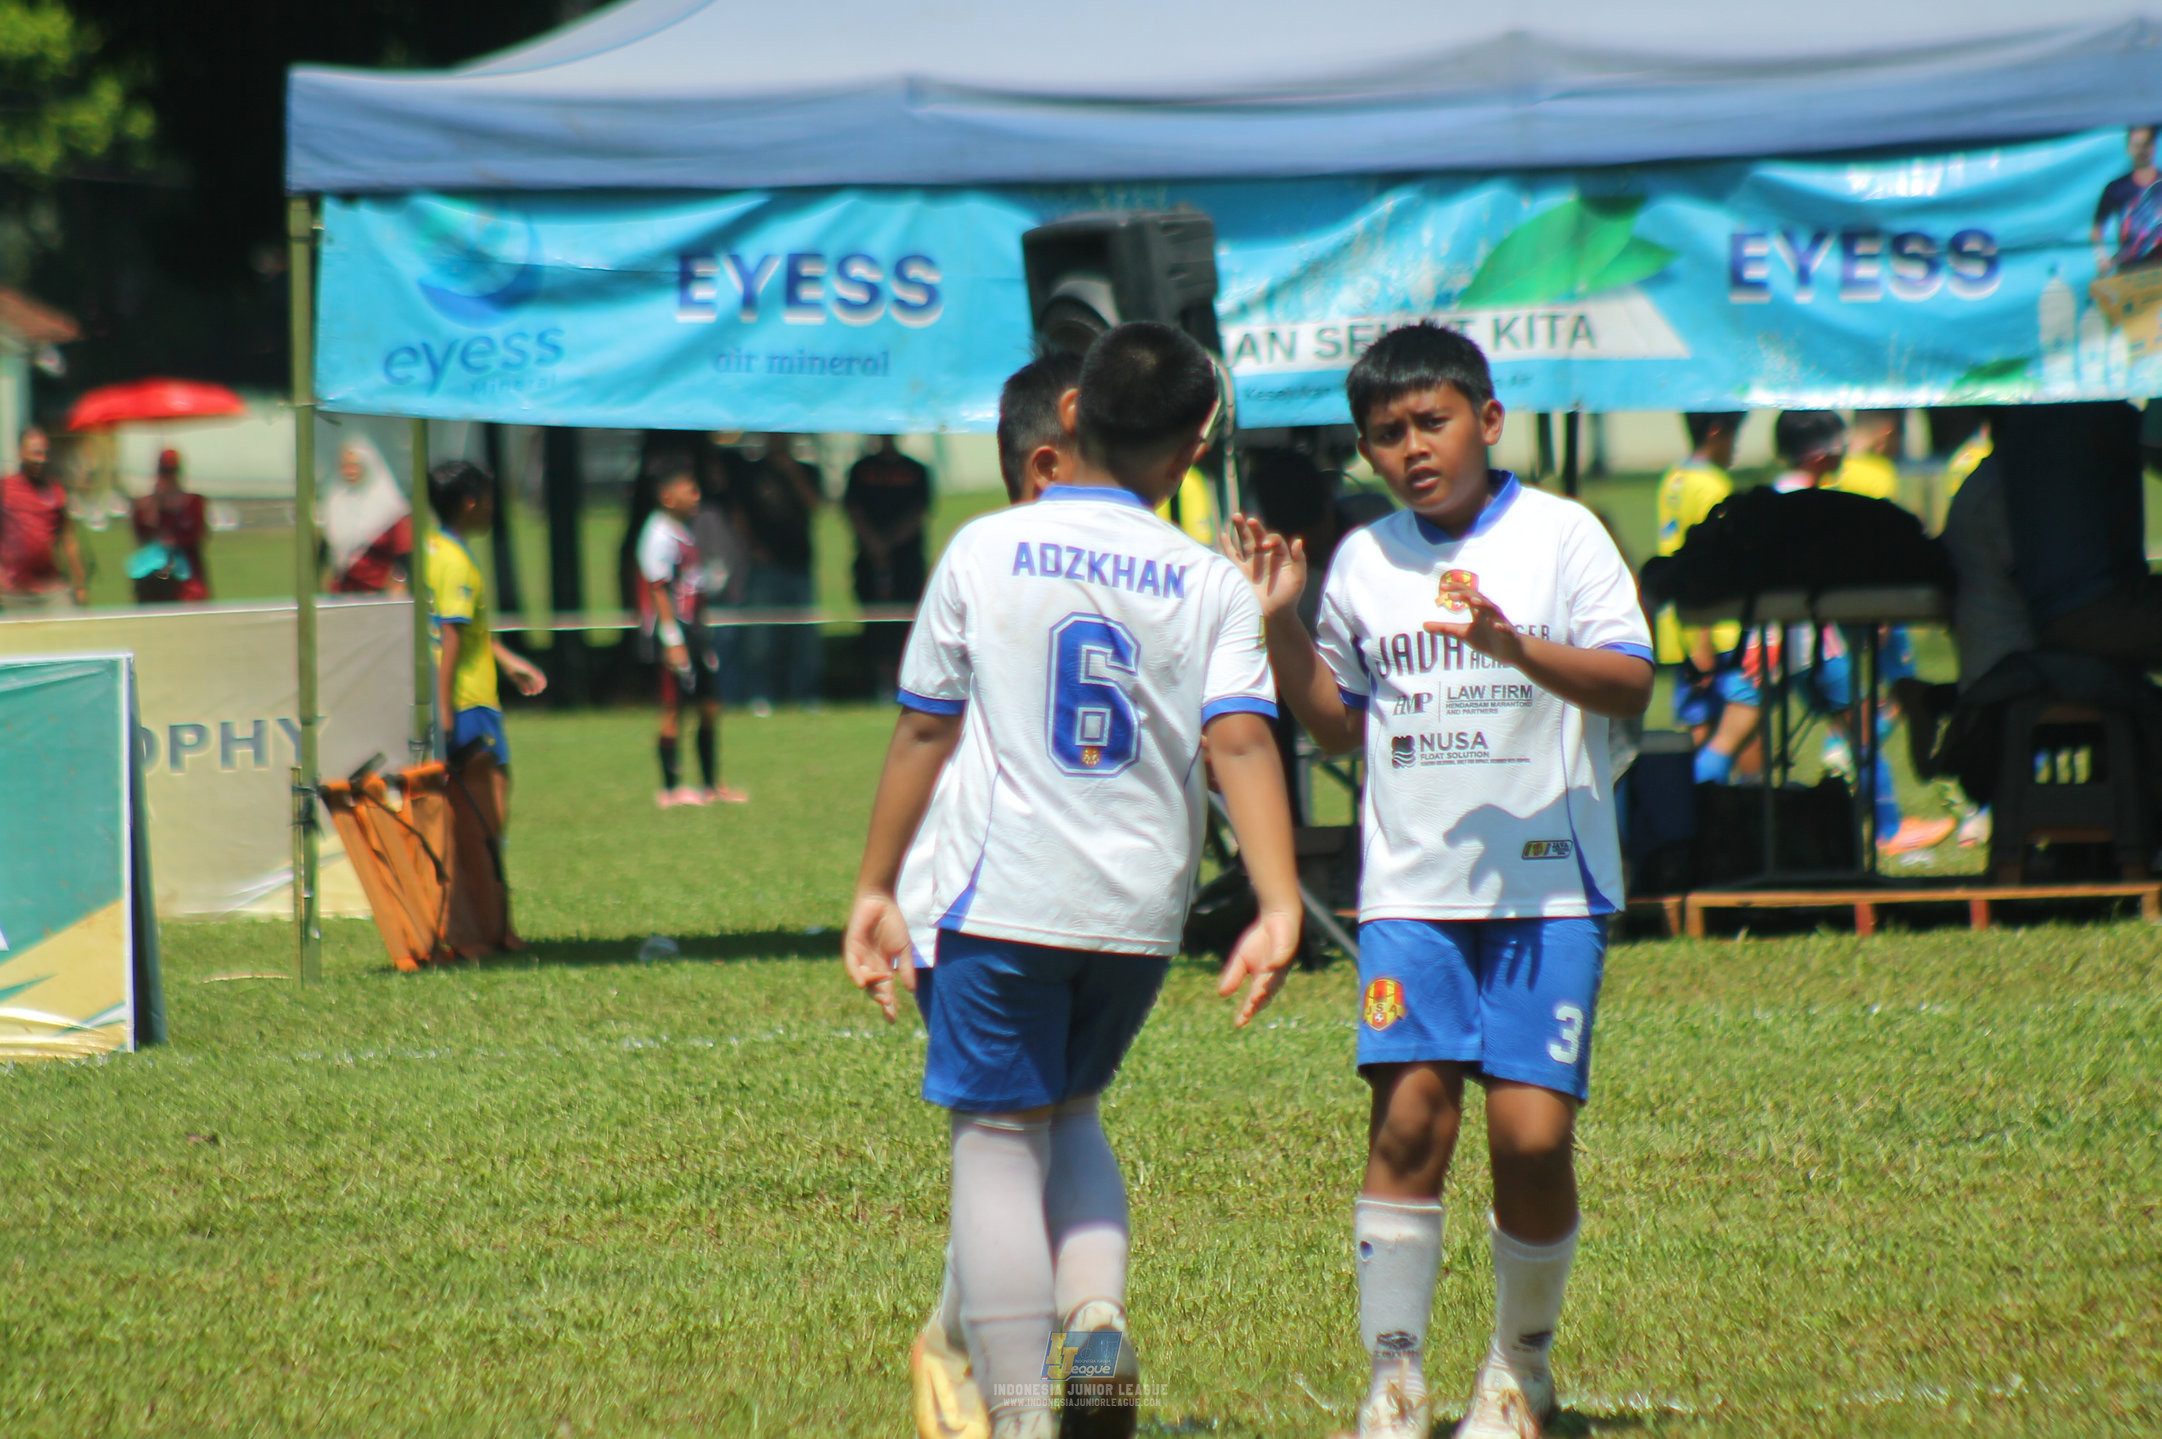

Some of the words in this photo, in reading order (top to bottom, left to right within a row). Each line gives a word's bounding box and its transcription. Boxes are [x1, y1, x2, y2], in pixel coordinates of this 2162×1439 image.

[677, 252, 944, 328] EYESS
[1729, 228, 2002, 304] EYESS
[1493, 312, 1598, 350] KITA
[384, 327, 566, 397] eyess
[766, 350, 890, 377] mineral
[1046, 611, 1142, 778] 6
[1447, 685, 1486, 700] LAW
[1491, 684, 1533, 699] FIRM
[1420, 731, 1489, 752] NUSA
[1420, 753, 1445, 761] FLOAT
[1446, 751, 1490, 759] SOLUTION
[1549, 1005, 1584, 1065] 3
